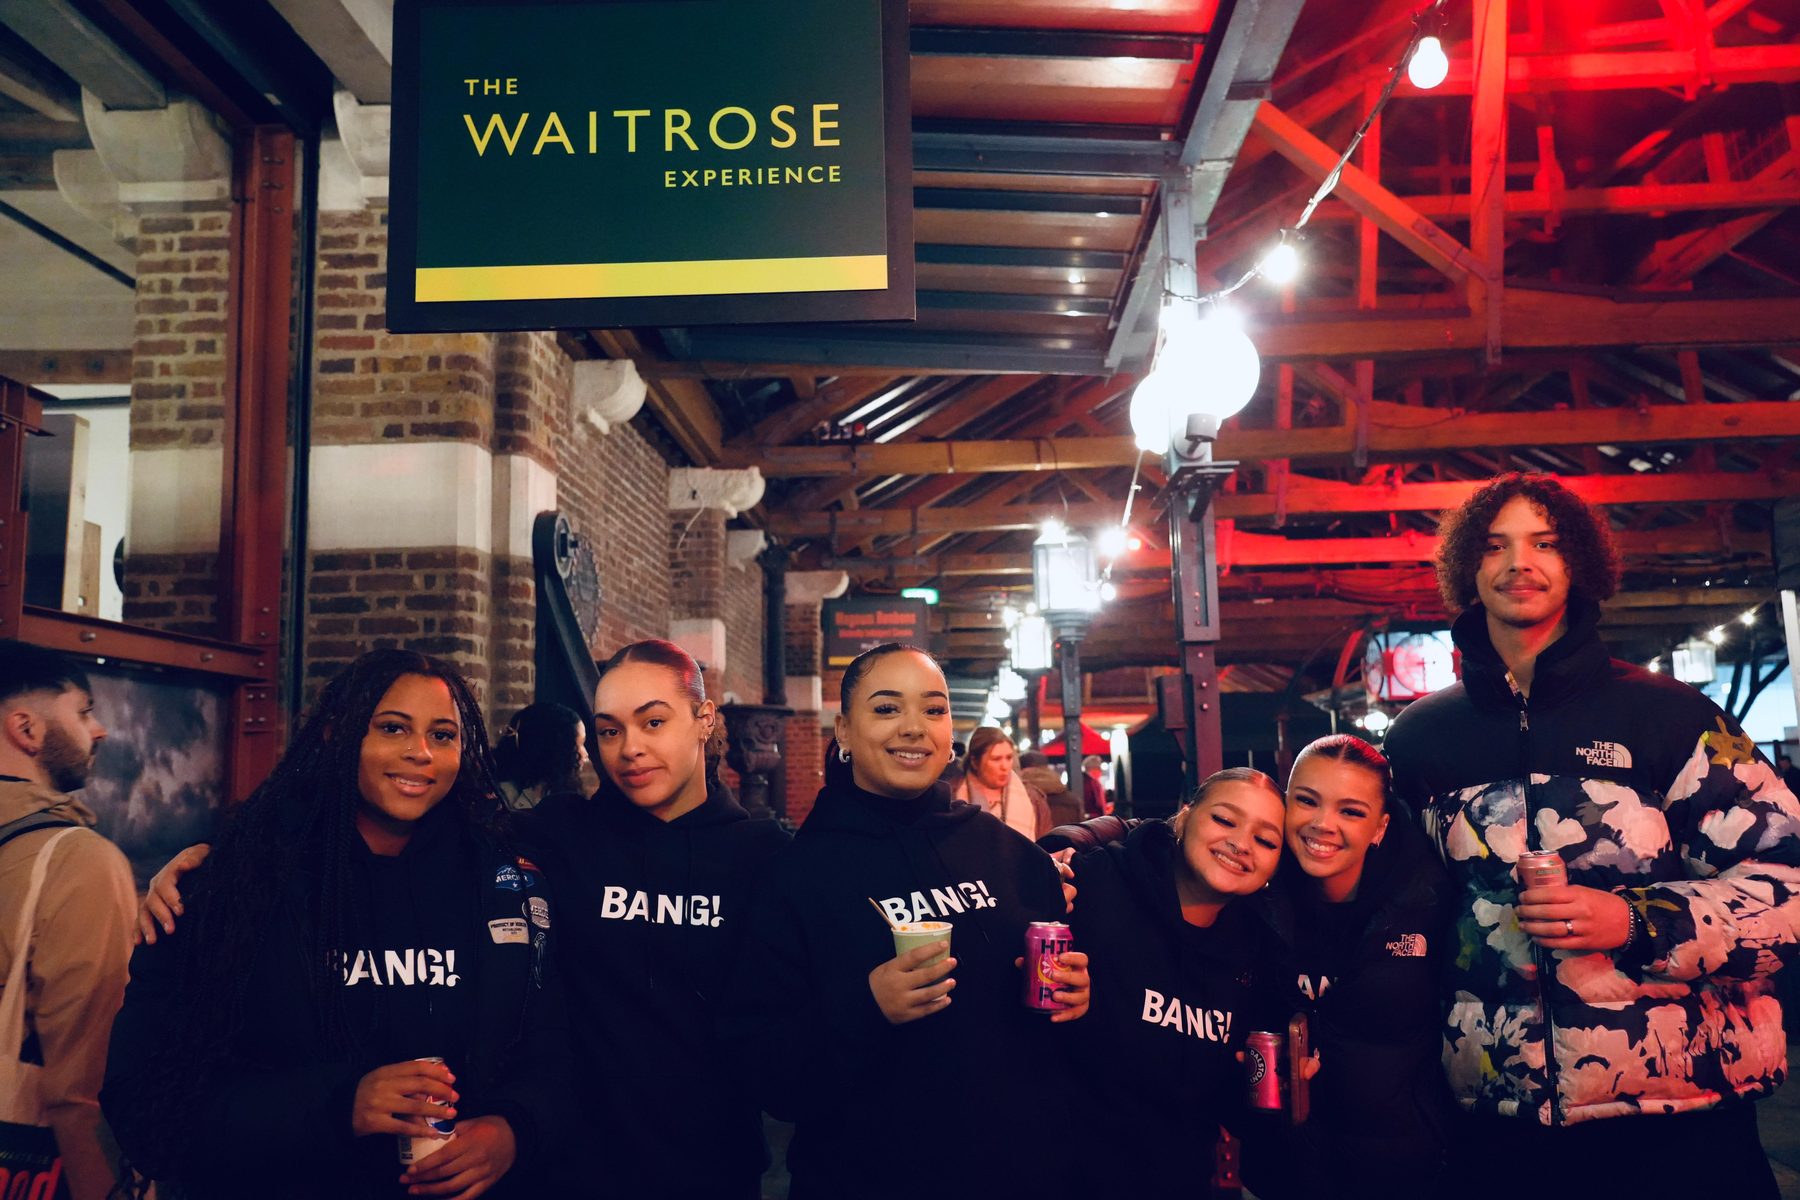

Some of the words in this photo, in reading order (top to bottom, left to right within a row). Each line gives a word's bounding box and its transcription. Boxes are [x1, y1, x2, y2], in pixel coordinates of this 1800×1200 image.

[464, 78, 518, 95] THE
[463, 104, 841, 156] WAITROSE
[665, 166, 841, 187] EXPERIENCE
[1576, 747, 1613, 758] NORTH
[1592, 741, 1613, 750] THE
[1587, 757, 1613, 767] FACE
[600, 886, 724, 928] BANG!
[879, 880, 997, 923] BANG!
[1386, 942, 1414, 950] NORTH
[1401, 934, 1415, 942] THE
[1142, 988, 1232, 1044] BANG!
